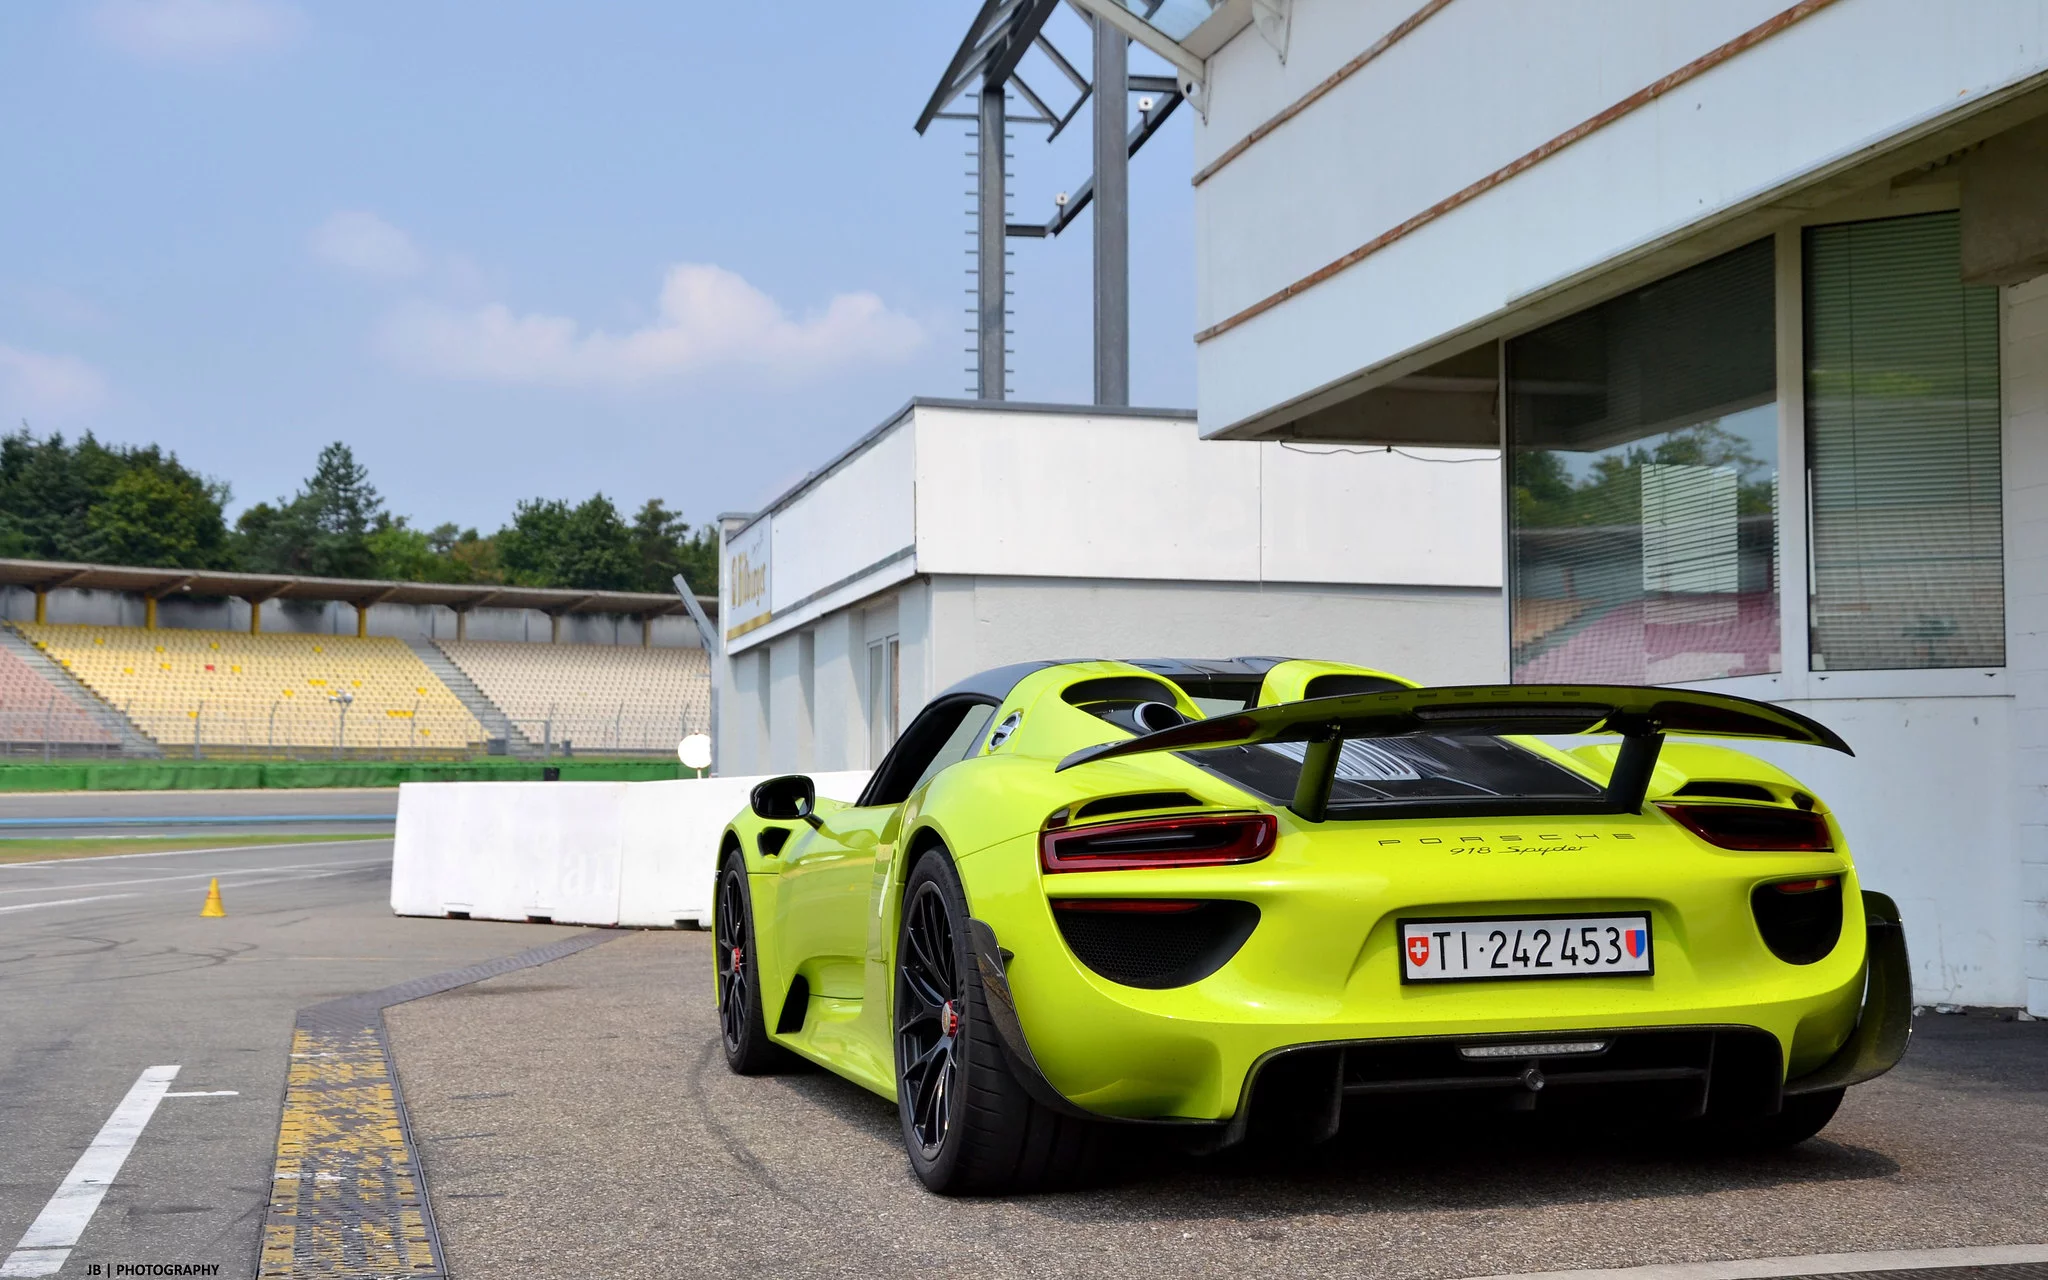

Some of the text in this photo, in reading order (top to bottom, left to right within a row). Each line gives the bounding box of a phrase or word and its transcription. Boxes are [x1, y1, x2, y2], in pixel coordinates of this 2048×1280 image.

[1378, 833, 1636, 846] PORSCHE
[1450, 845, 1588, 855] 918 Spyder
